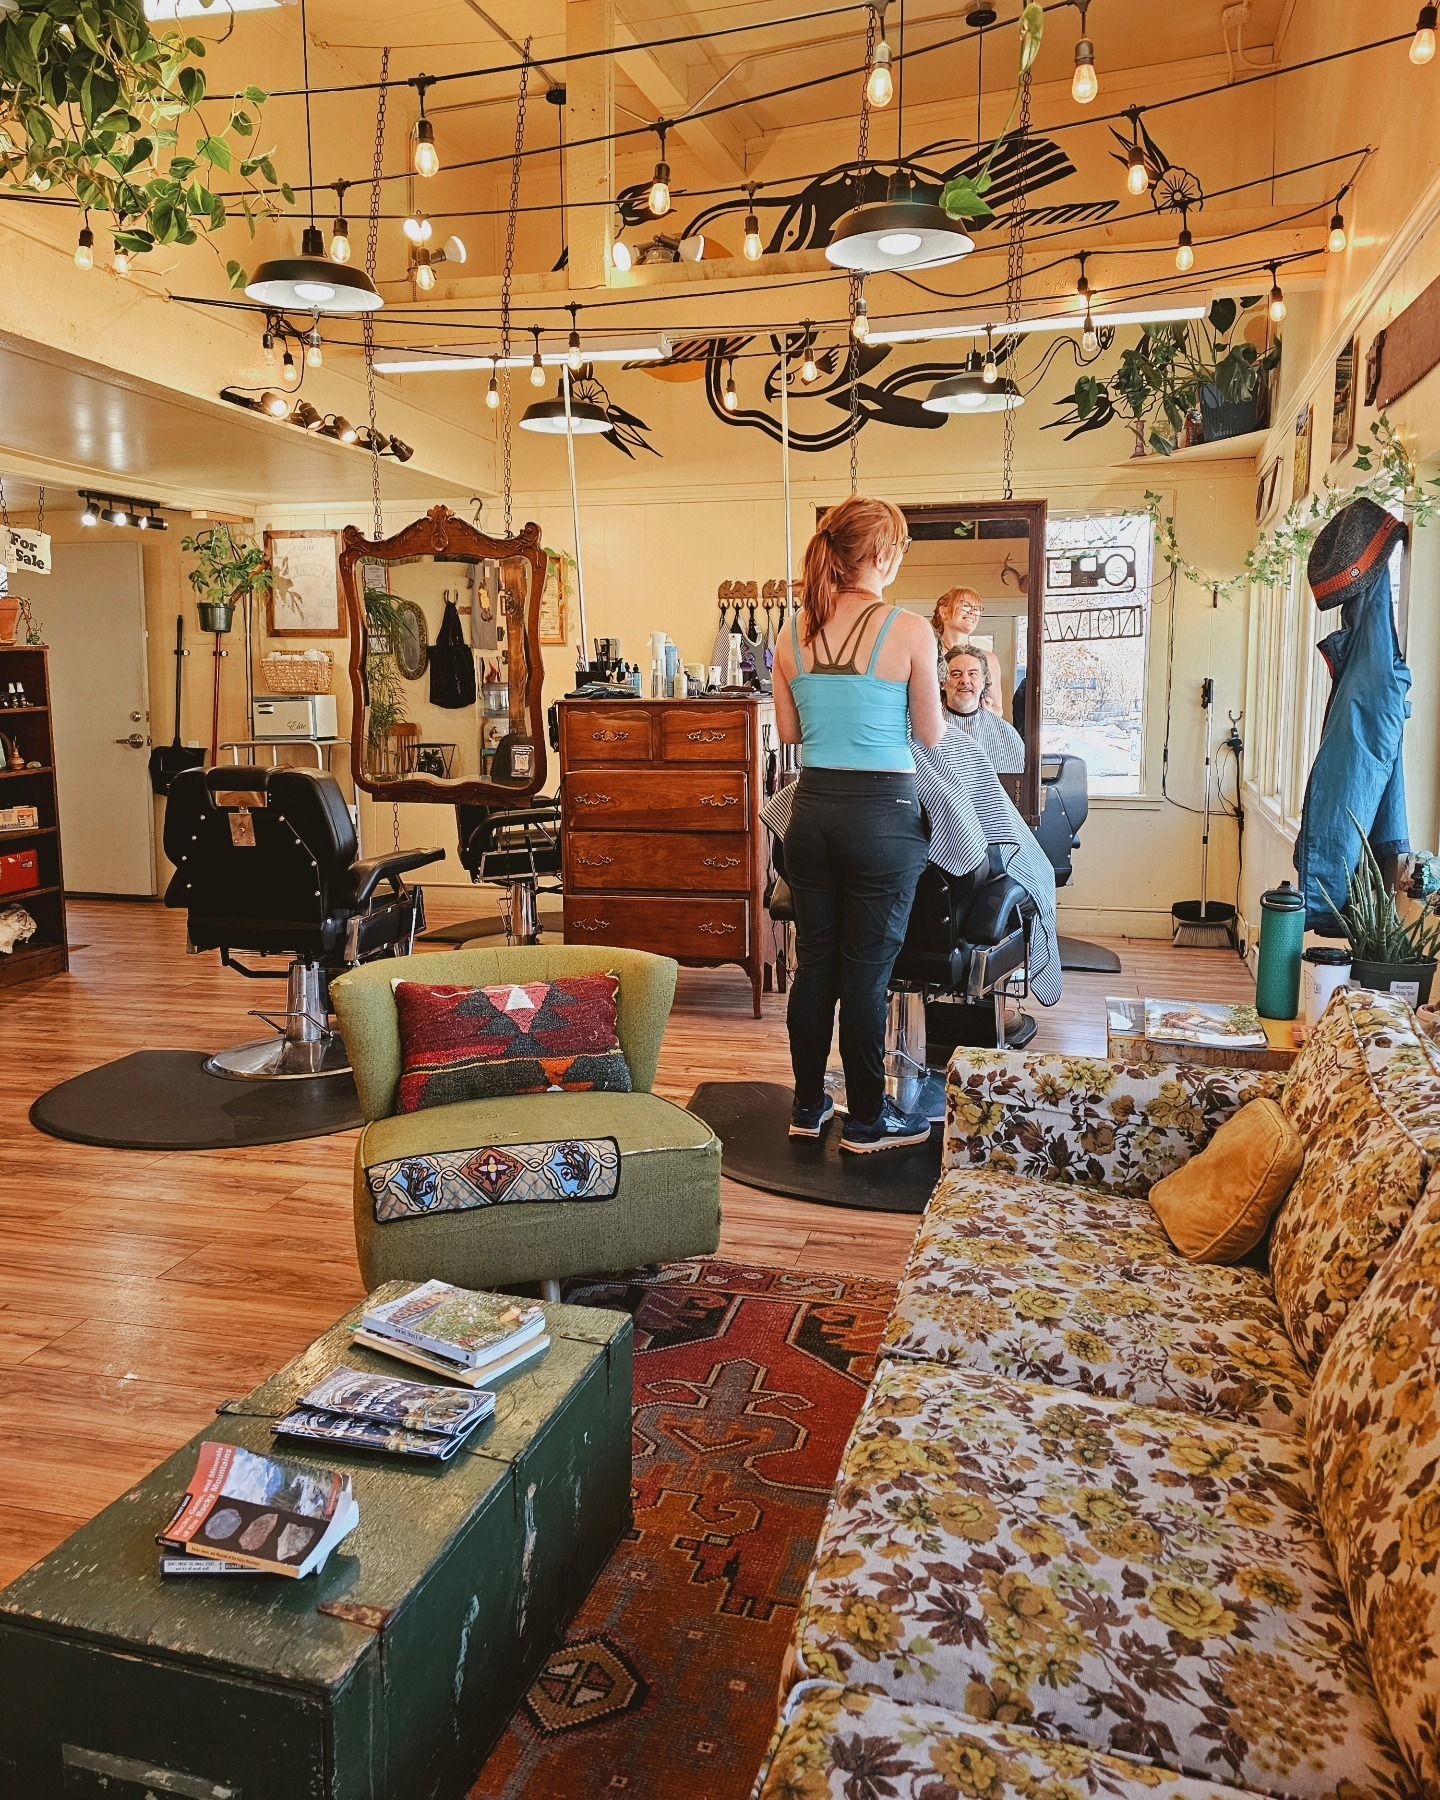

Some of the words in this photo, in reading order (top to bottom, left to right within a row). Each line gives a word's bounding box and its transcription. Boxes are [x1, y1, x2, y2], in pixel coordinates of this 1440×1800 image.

[11, 532, 37, 552] For
[16, 548, 44, 569] Sale
[287, 721, 306, 731] Elite
[390, 1291, 454, 1322] COLORADO
[203, 1479, 212, 1492] and
[208, 1448, 223, 1477] Minerals
[188, 1519, 199, 1530] the
[196, 1494, 215, 1517] Rocky
[210, 1449, 231, 1492] Mountains
